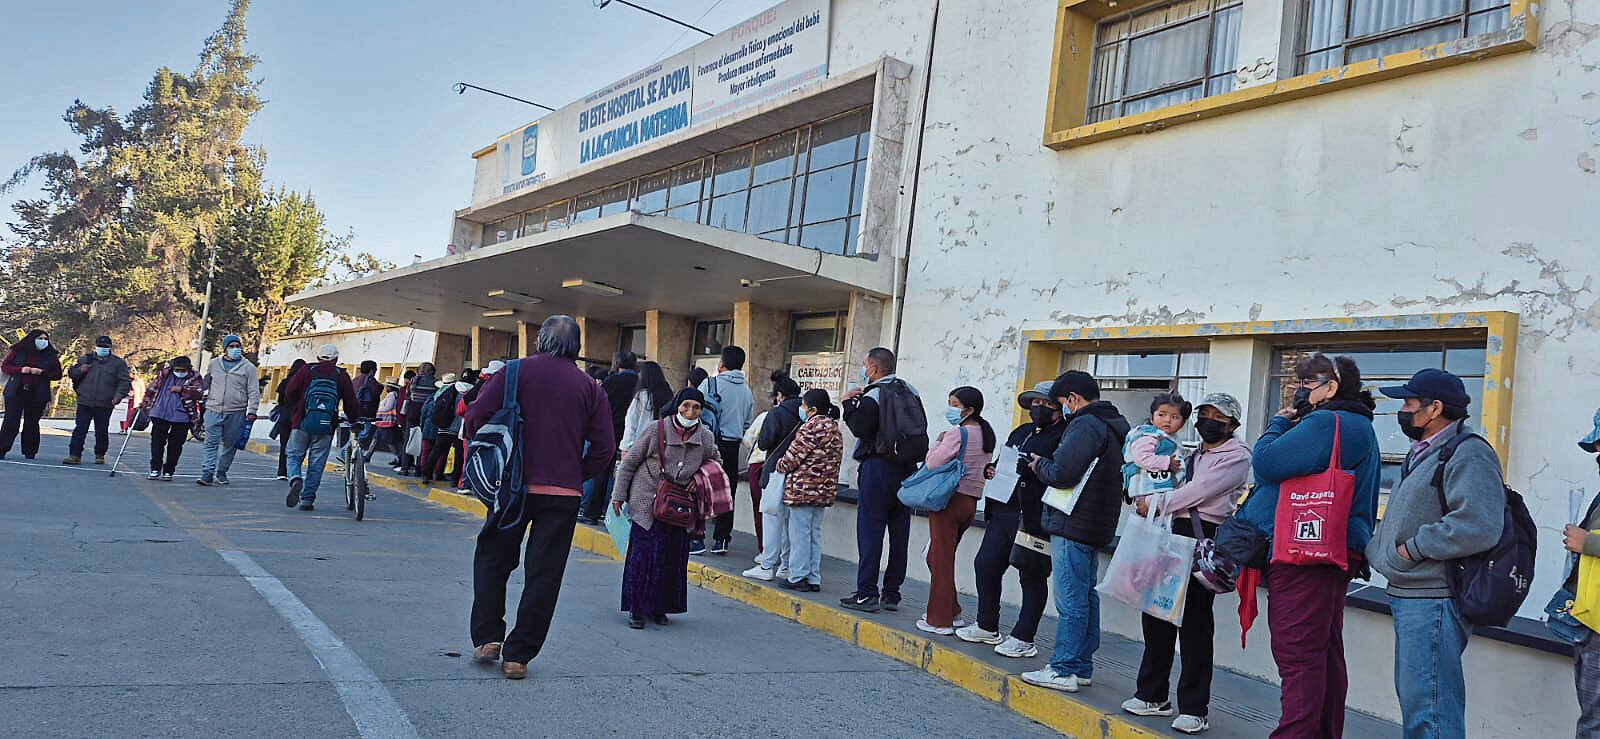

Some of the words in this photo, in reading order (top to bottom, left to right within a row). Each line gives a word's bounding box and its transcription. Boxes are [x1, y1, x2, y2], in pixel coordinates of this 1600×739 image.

[697, 61, 718, 77] Favorece
[718, 55, 724, 67] el
[724, 45, 747, 65] desarrollo
[748, 39, 763, 56] físico
[768, 23, 795, 46] emocional
[795, 16, 805, 33] del
[805, 10, 819, 28] bebé
[718, 65, 737, 83] Produce
[737, 60, 754, 75] menos
[755, 43, 793, 68] enfermedades
[579, 111, 589, 132] EN
[590, 103, 606, 128] ESTE
[608, 86, 645, 121] HOSPITAL
[647, 80, 657, 104] SE
[659, 66, 690, 100] APOYA
[729, 79, 746, 96] Mayor
[745, 65, 776, 89] inteligencia
[580, 140, 590, 163] LA
[591, 121, 638, 159] LACTANCIA
[640, 102, 688, 142] MATERNA
[1300, 522, 1316, 537] FA
